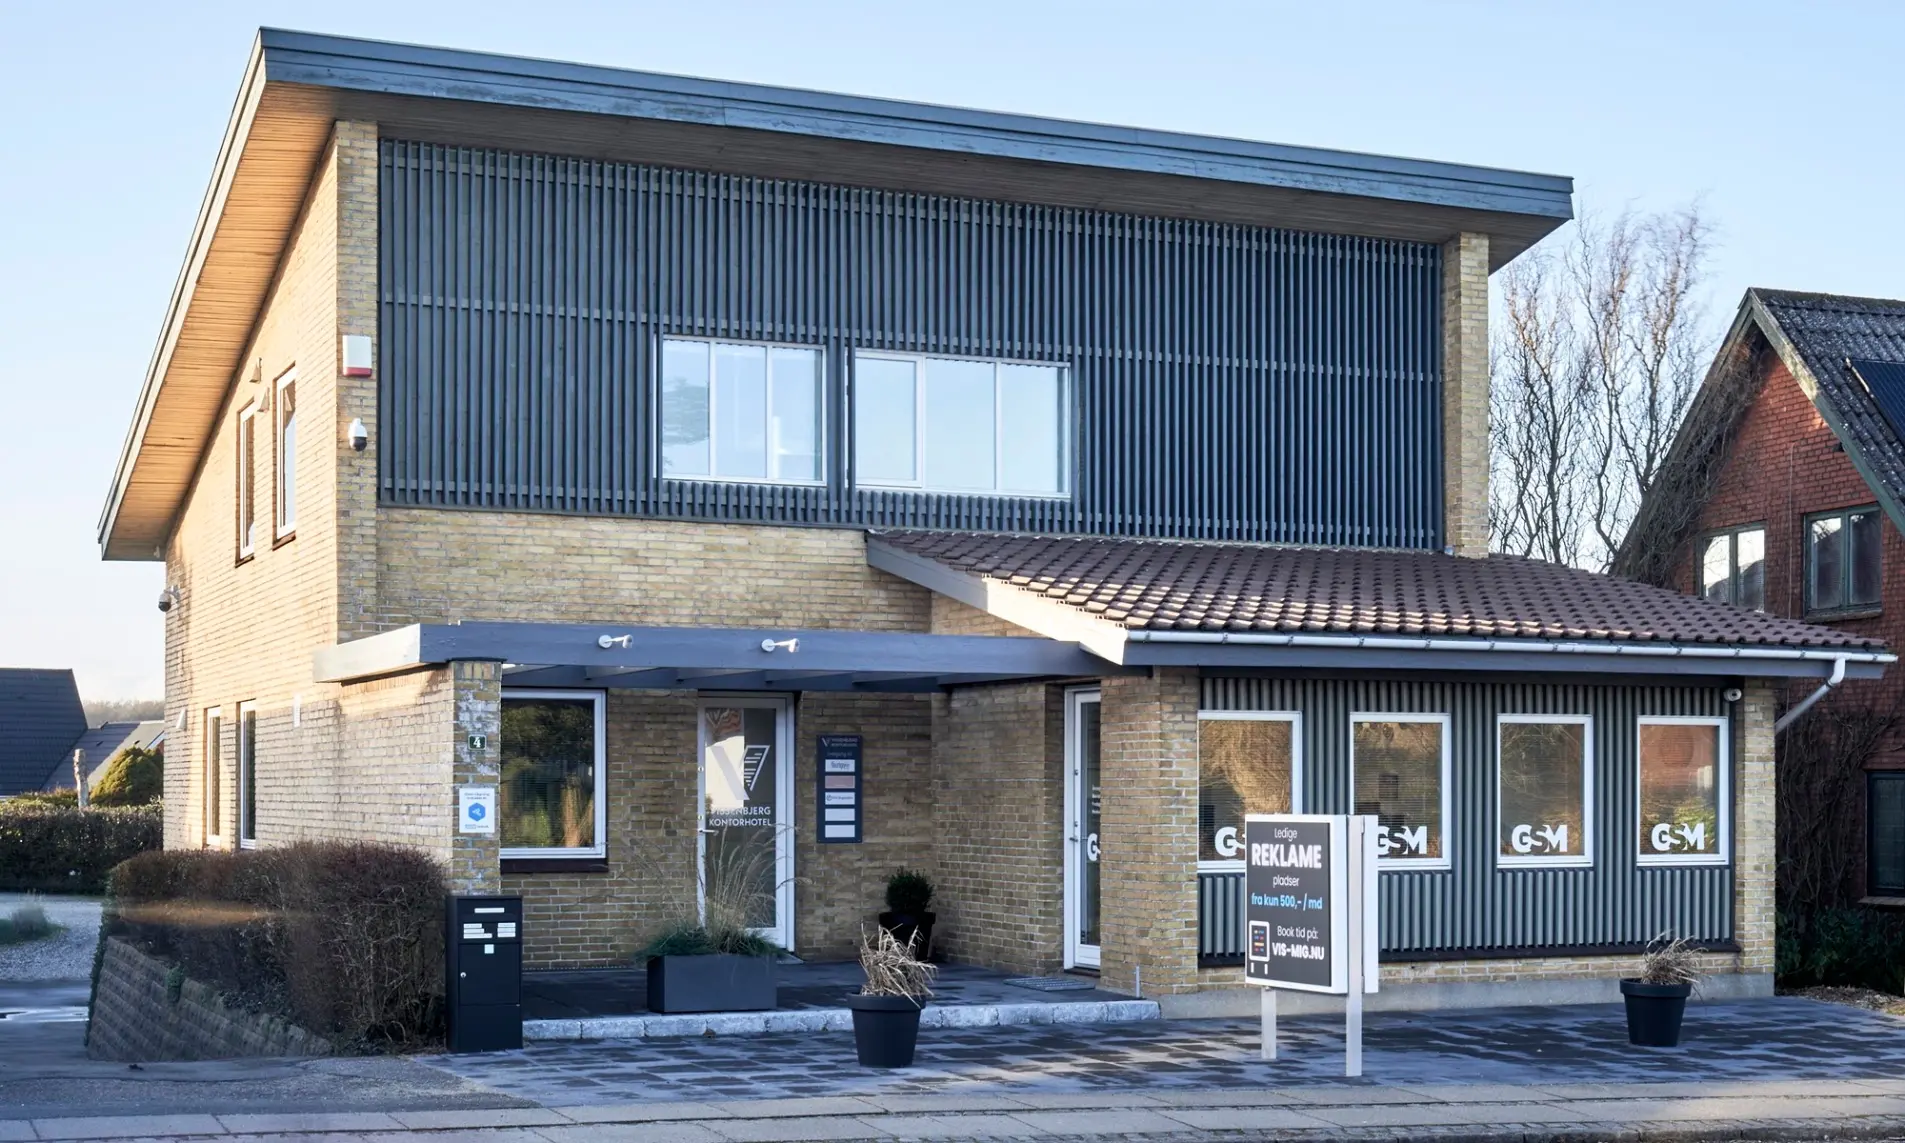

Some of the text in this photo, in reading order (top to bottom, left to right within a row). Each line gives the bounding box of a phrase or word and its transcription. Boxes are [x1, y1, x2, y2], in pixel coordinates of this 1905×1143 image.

[473, 736, 482, 748] 4
[709, 818, 772, 827] KONTORHOTEL
[1274, 827, 1298, 842] Ledige
[1378, 825, 1428, 855] GSM
[1511, 824, 1568, 853] GSM
[1651, 822, 1706, 851] GSM
[1251, 843, 1322, 869] REKLAME
[1273, 873, 1300, 888] pladser
[1251, 892, 1263, 905] fra
[1264, 893, 1279, 906] kun
[1308, 896, 1323, 909] md
[1277, 925, 1295, 937] Book
[1296, 926, 1306, 938] tid
[1272, 942, 1325, 960] VIS-MIG.NU
